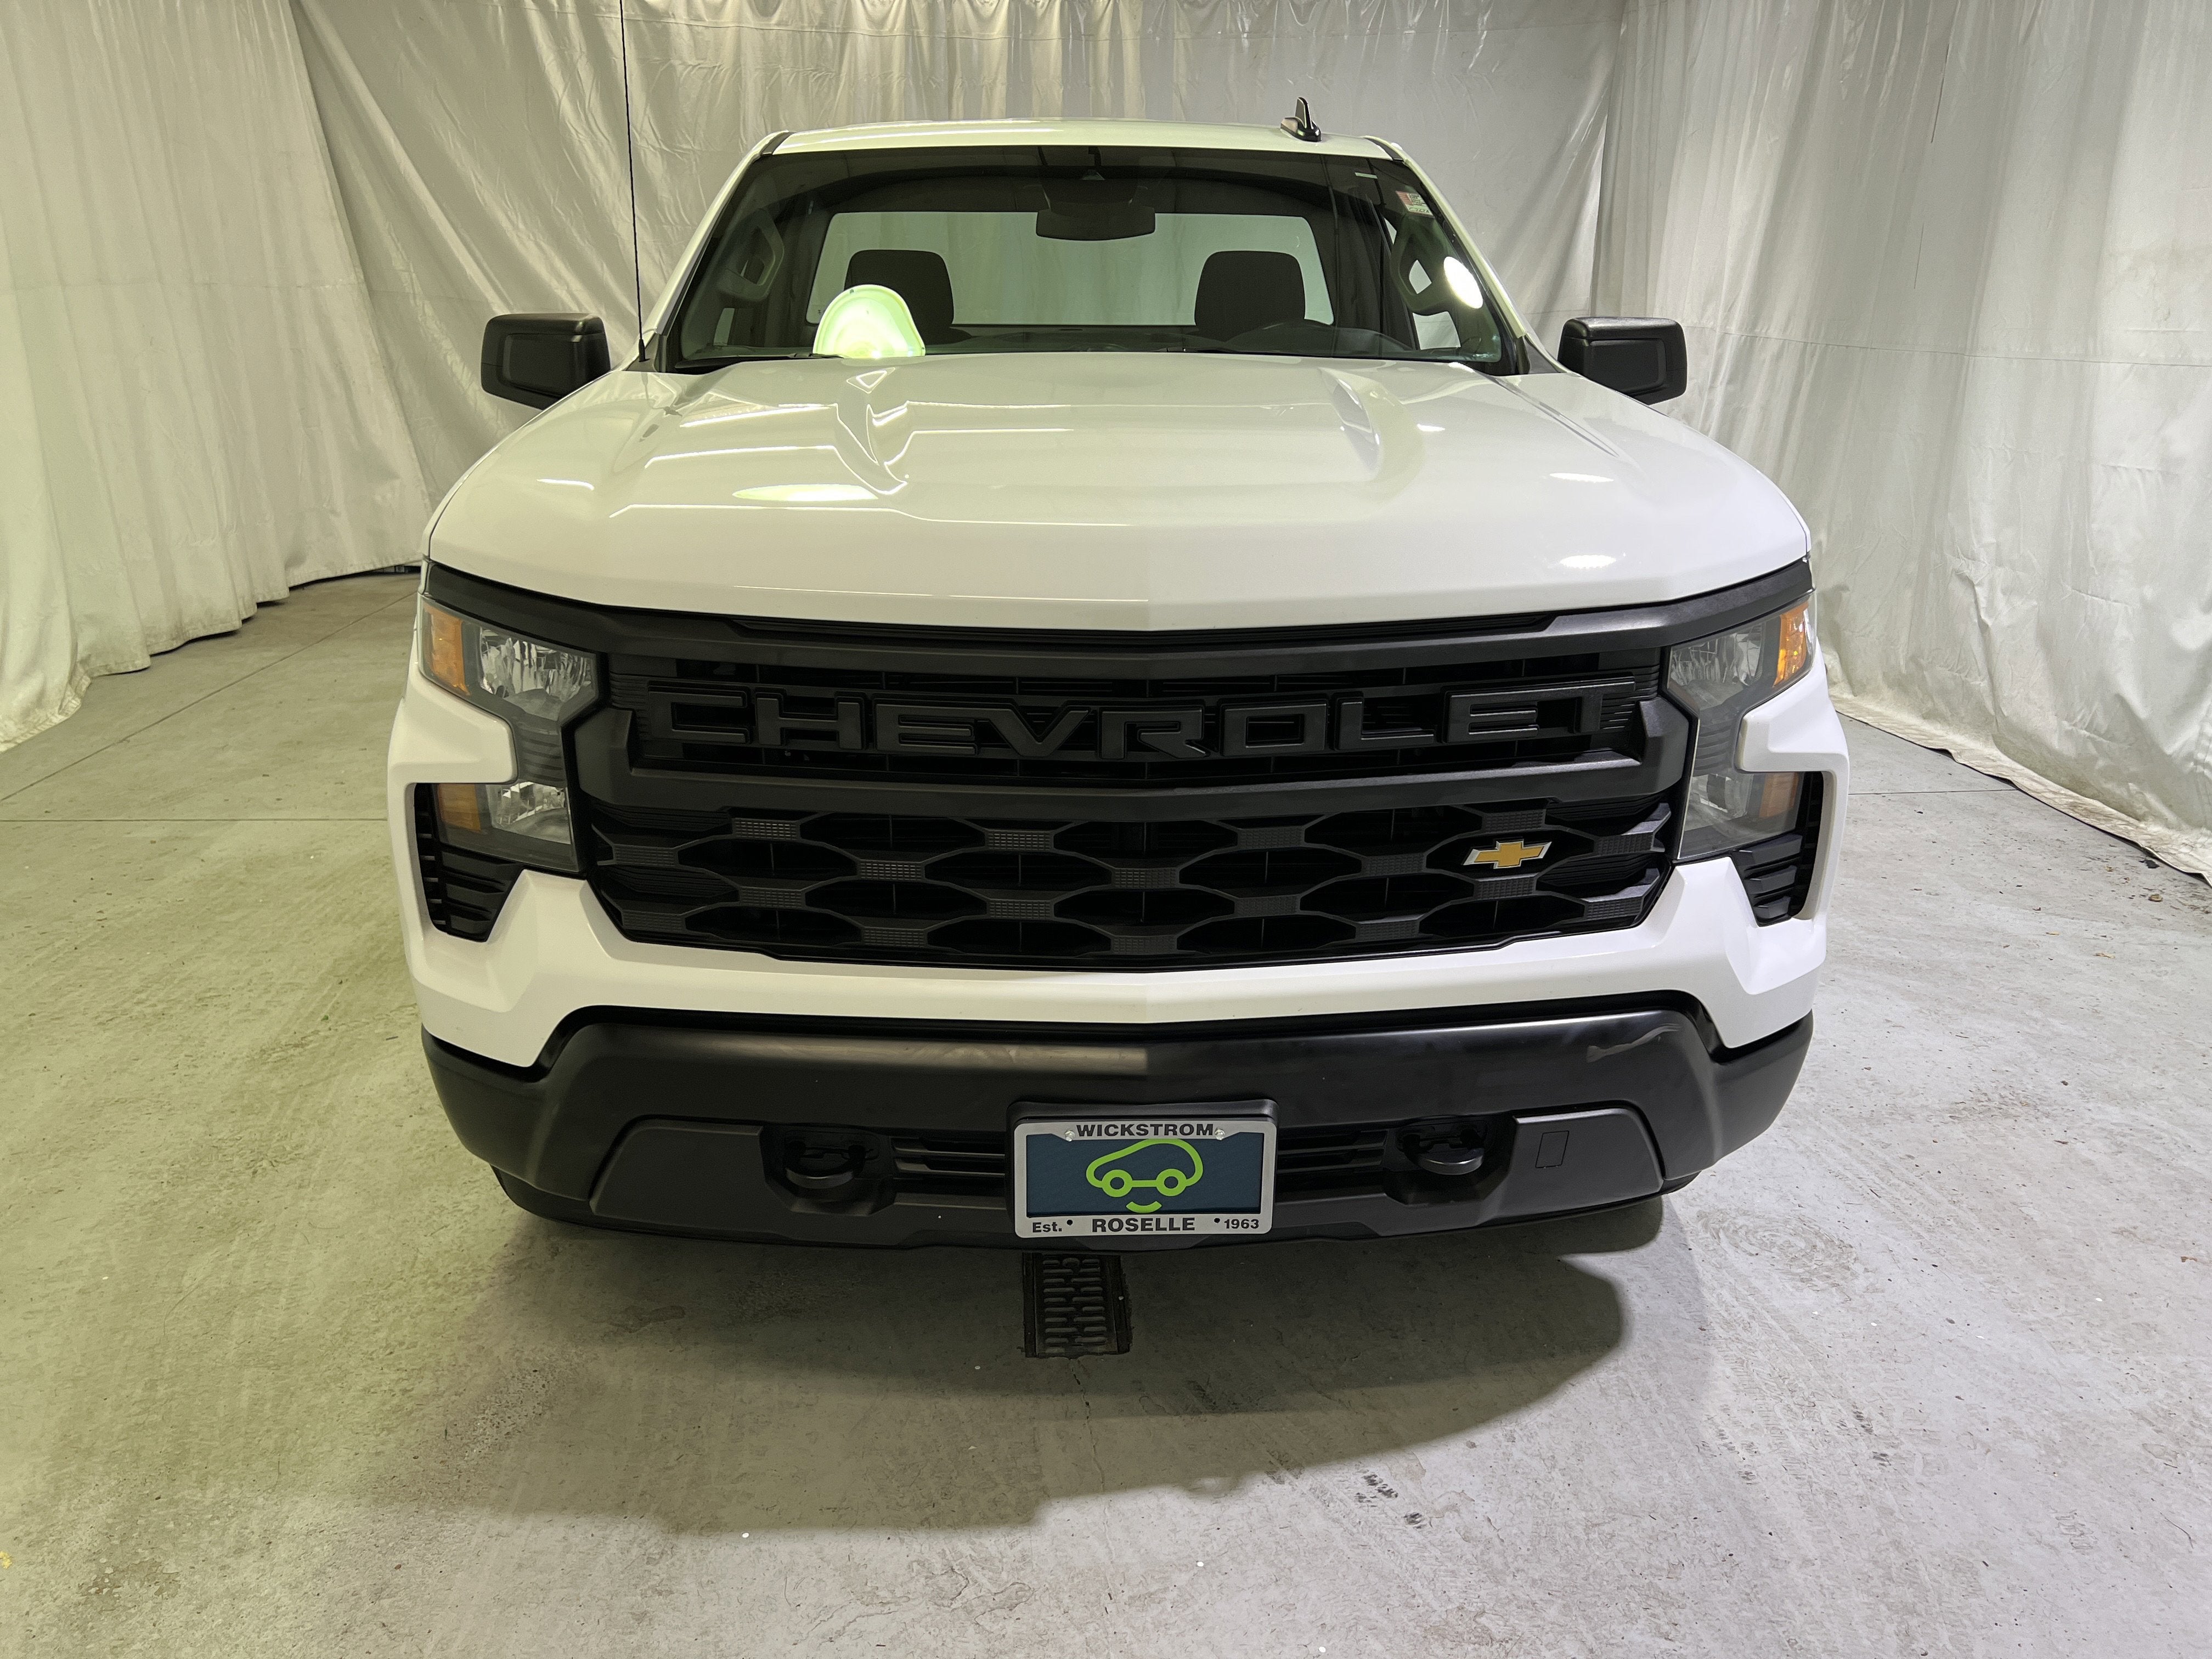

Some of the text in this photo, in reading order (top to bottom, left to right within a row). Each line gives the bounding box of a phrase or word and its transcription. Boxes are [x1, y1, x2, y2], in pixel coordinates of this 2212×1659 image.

[648, 675, 1635, 759] CHEVROLET
[1076, 1123, 1214, 1137] WICKSTROM
[1032, 1217, 1260, 1233] Est. ROSELLE 1963
